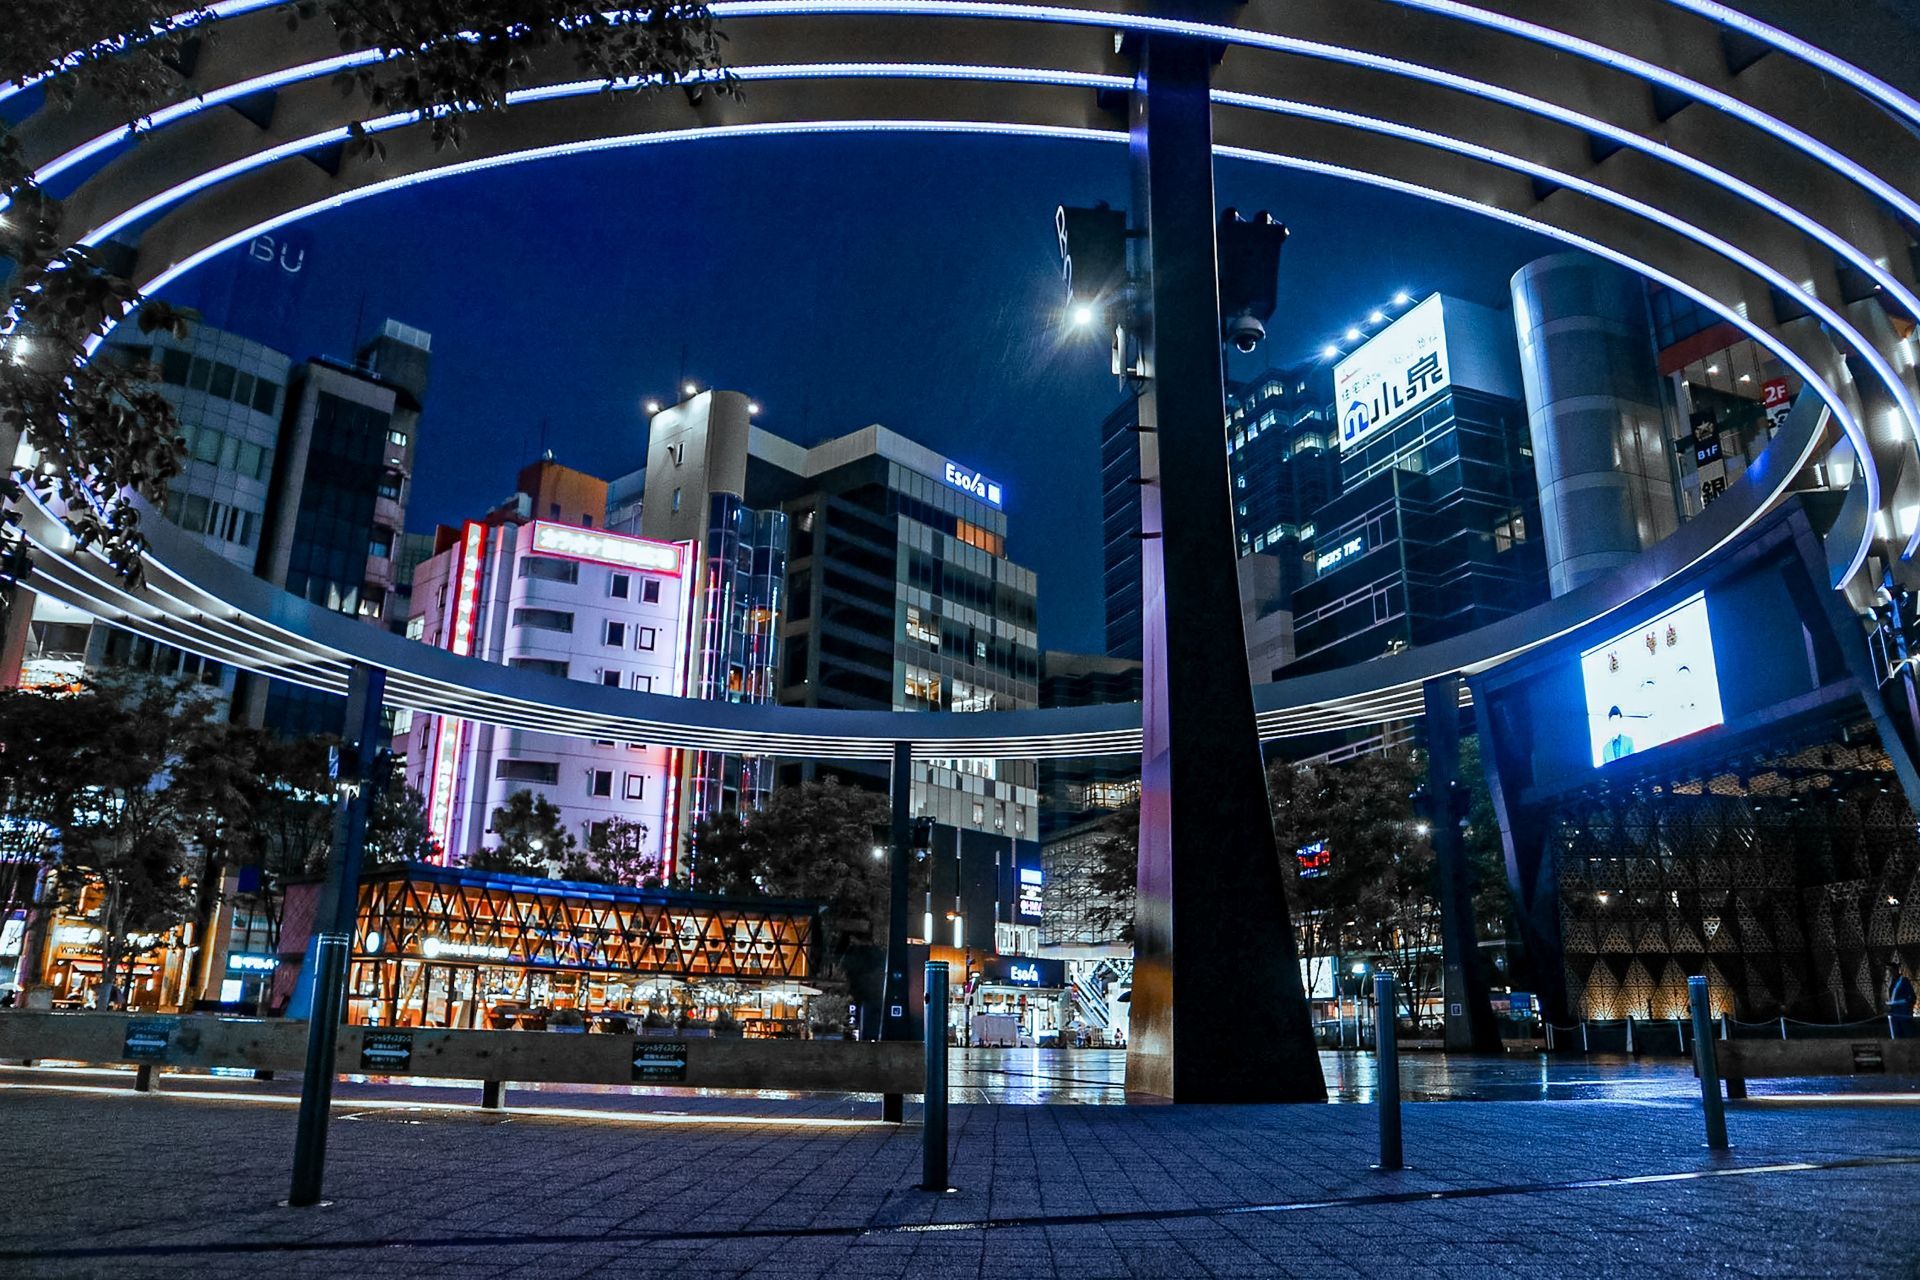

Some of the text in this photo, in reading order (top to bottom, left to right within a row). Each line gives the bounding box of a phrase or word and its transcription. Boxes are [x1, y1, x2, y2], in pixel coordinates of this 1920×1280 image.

[1764, 384, 1786, 403] 2F
[1697, 444, 1718, 461] B1F
[945, 462, 986, 498] Esola
